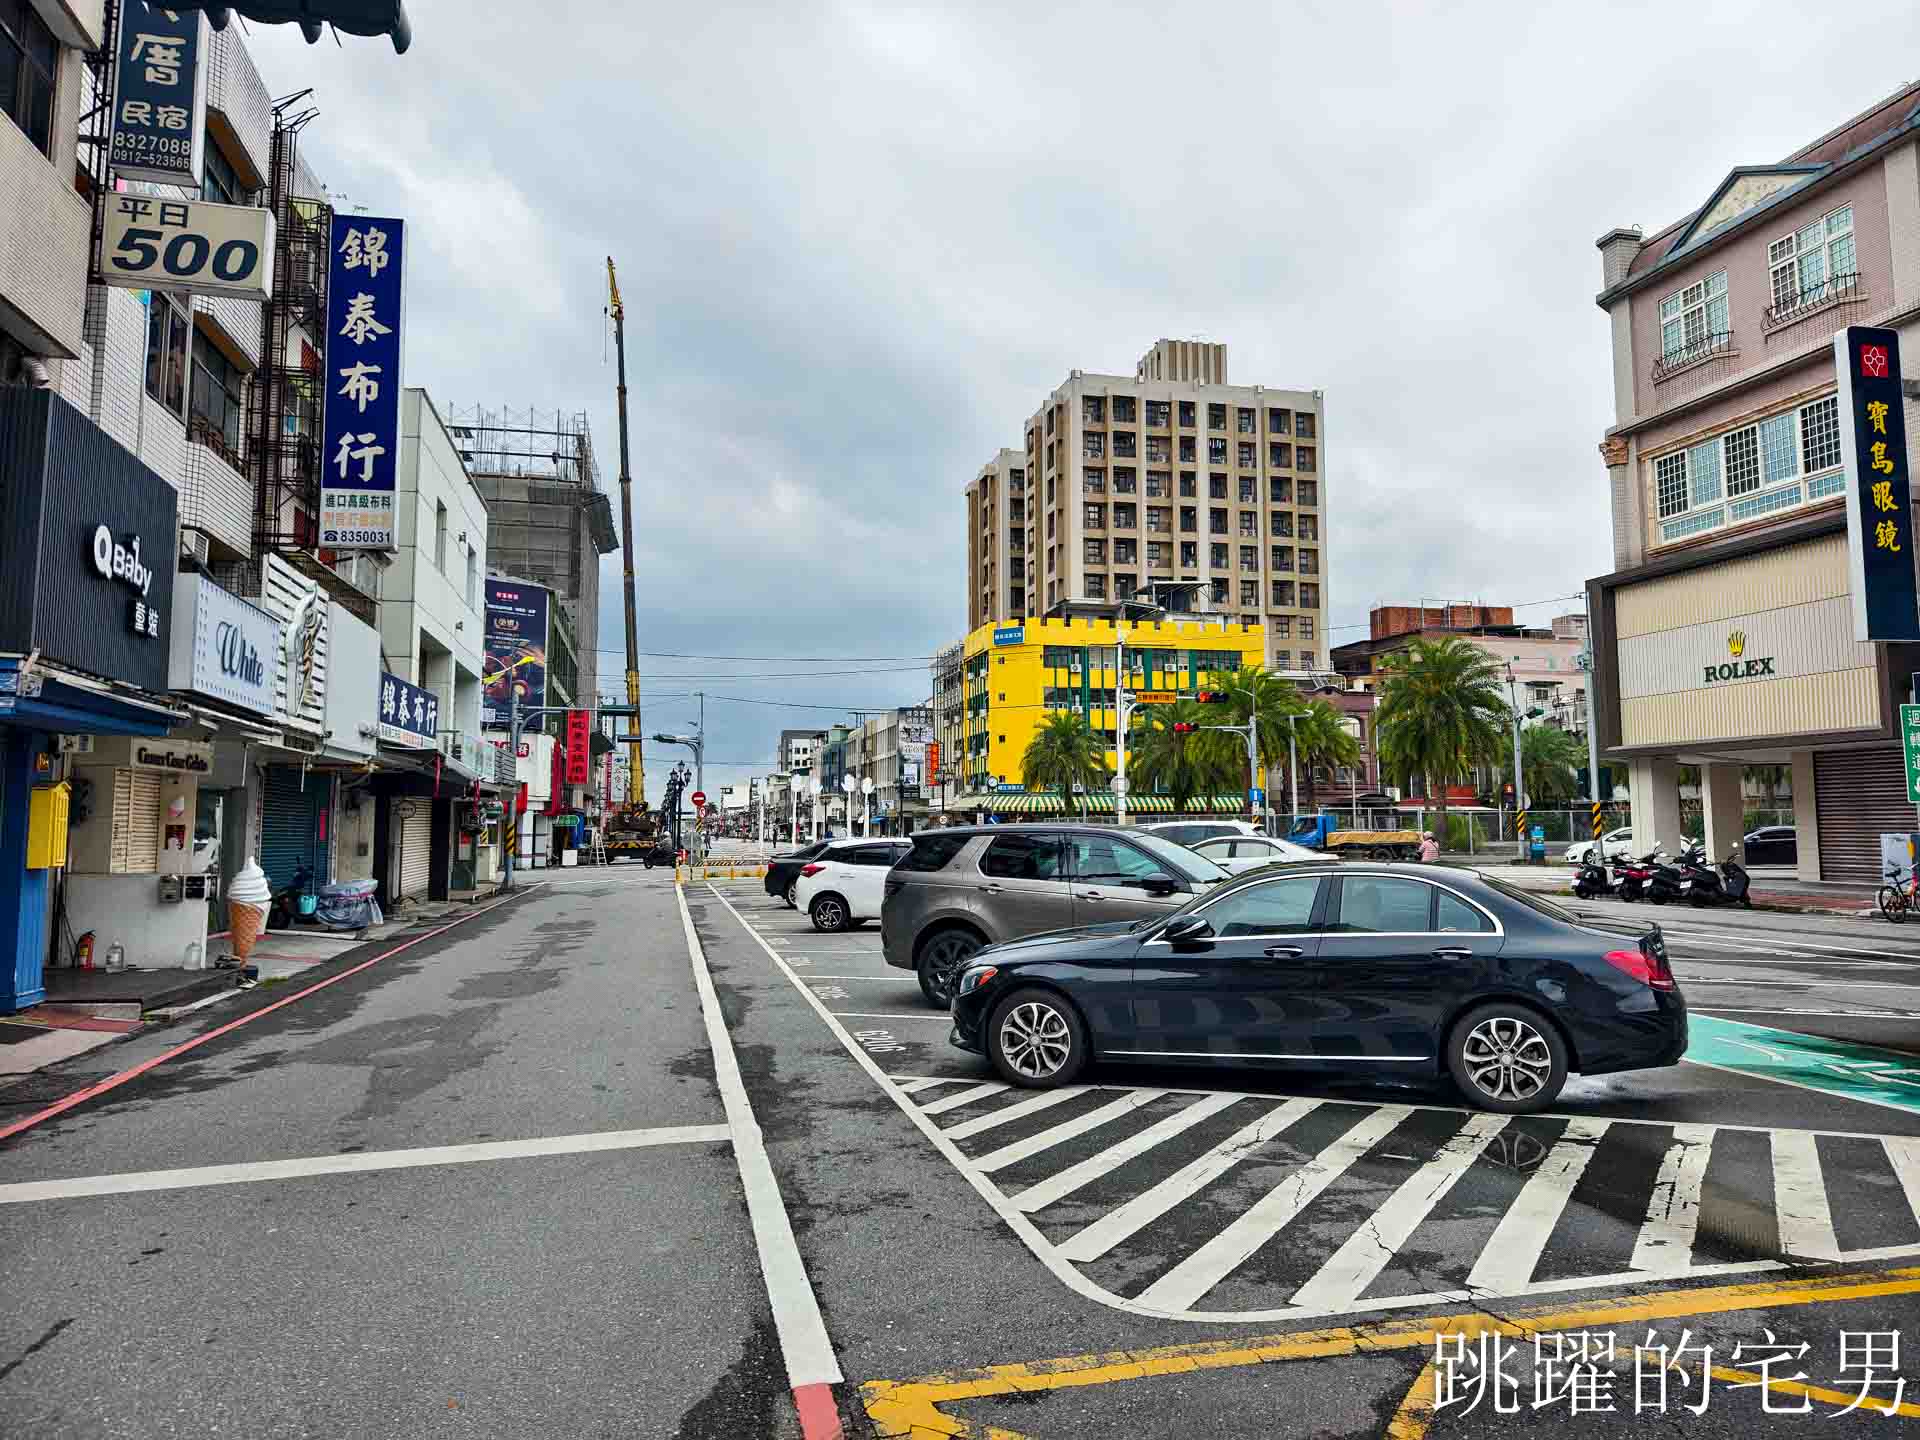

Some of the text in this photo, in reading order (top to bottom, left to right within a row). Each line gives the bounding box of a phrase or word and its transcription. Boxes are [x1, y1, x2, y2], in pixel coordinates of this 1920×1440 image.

[121, 100, 189, 131] 民宿
[114, 132, 191, 157] 8327088
[116, 197, 190, 229] 平日
[111, 228, 259, 282] 500
[332, 226, 393, 483] 錦泰布行
[1867, 400, 1901, 552] 寶島眼鏡
[325, 494, 391, 509] 進口高級布料
[341, 531, 391, 544] 8350031
[216, 621, 264, 687] White
[1703, 657, 1775, 682] ROLEX
[382, 680, 436, 735] 錦泰布行
